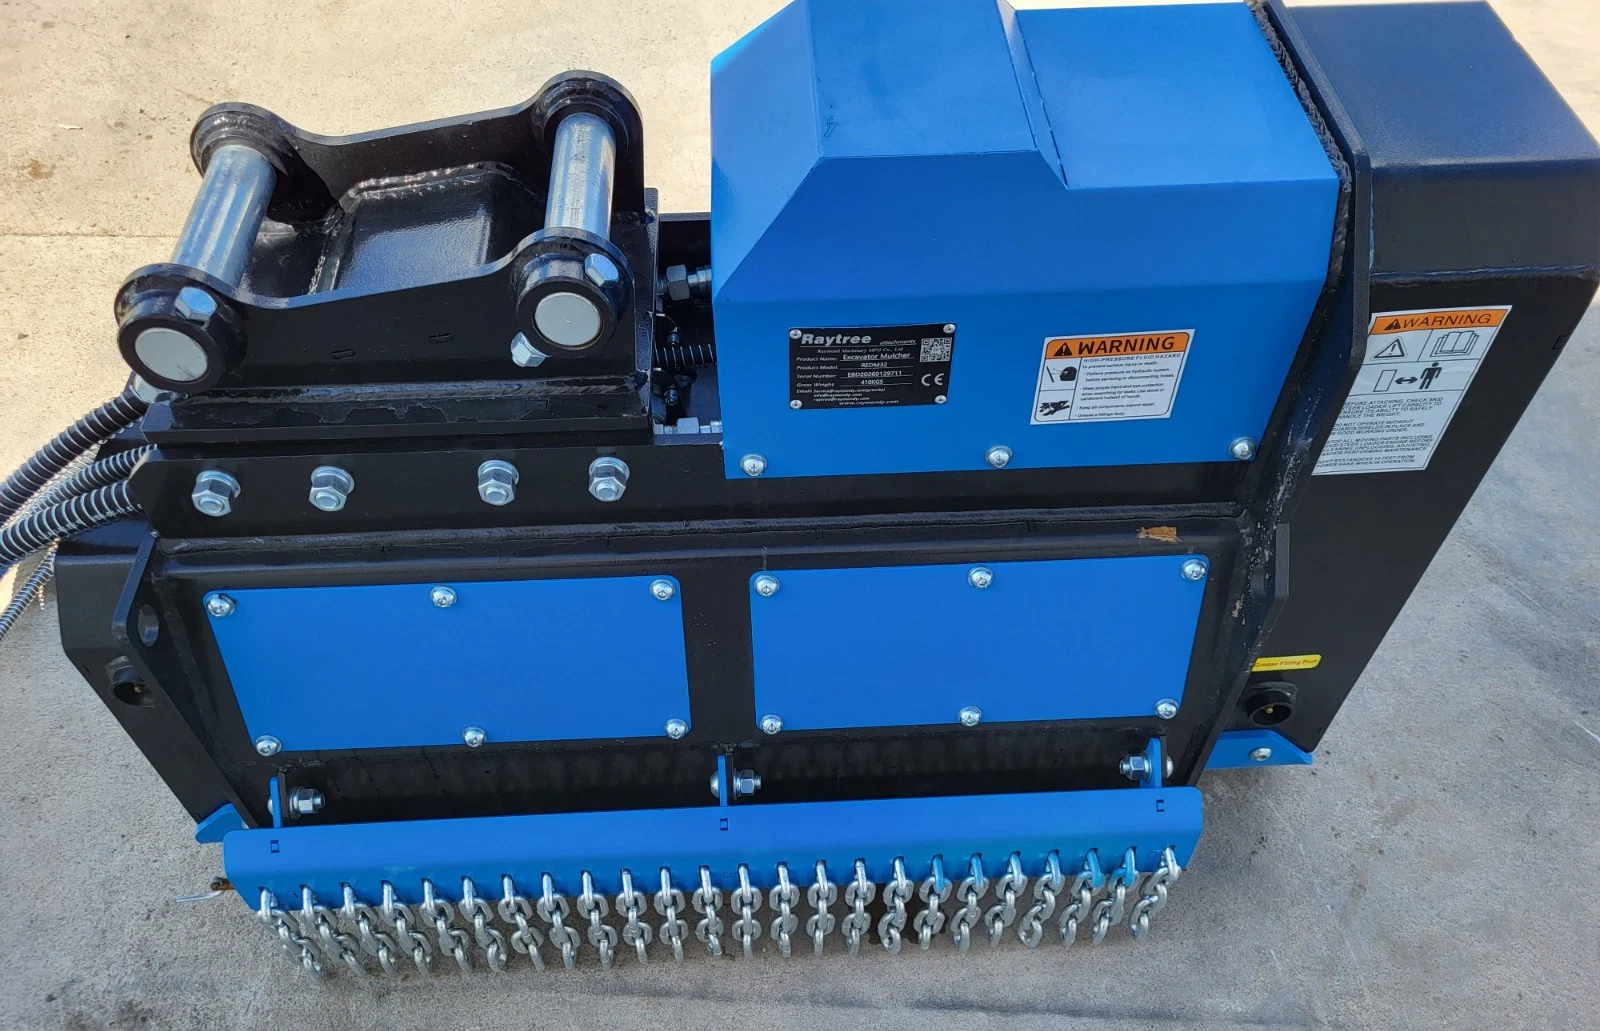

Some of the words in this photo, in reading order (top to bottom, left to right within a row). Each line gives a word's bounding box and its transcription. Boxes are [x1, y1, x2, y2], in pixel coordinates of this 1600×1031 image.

[1403, 314, 1492, 328] WARNING
[801, 334, 873, 347] Raytree
[1078, 336, 1175, 355] WARNING
